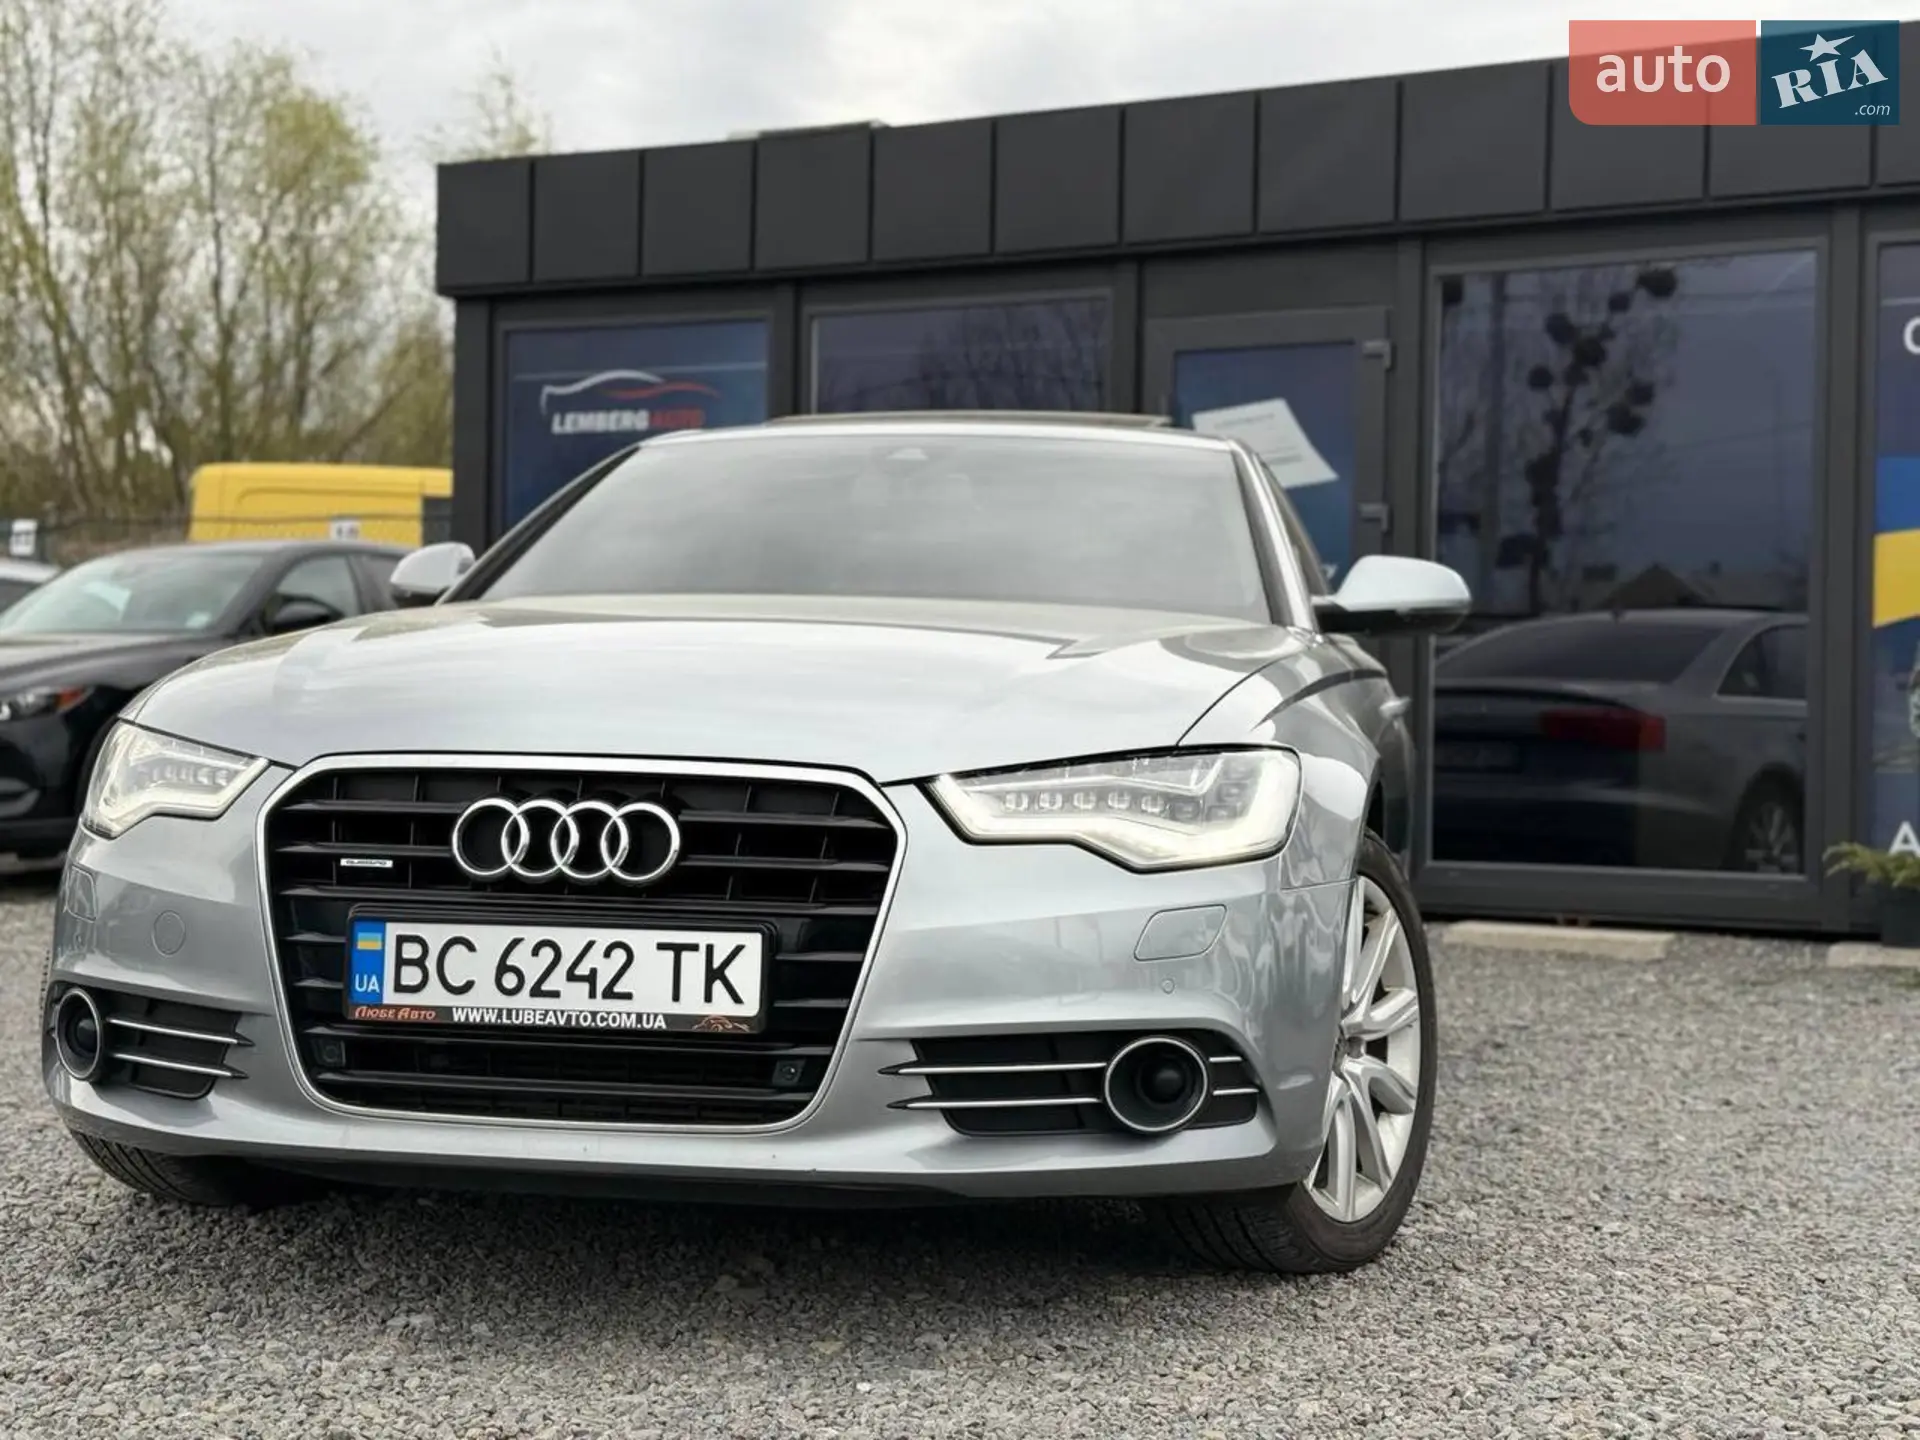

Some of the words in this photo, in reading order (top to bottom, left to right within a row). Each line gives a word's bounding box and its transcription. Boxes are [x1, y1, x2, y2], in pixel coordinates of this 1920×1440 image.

[393, 934, 477, 995] BC
[494, 937, 635, 1000] 6242
[656, 942, 747, 1004] TK
[354, 973, 381, 993] UA
[452, 1006, 667, 1030] WWW.LUBEAVTO.COM.UA
